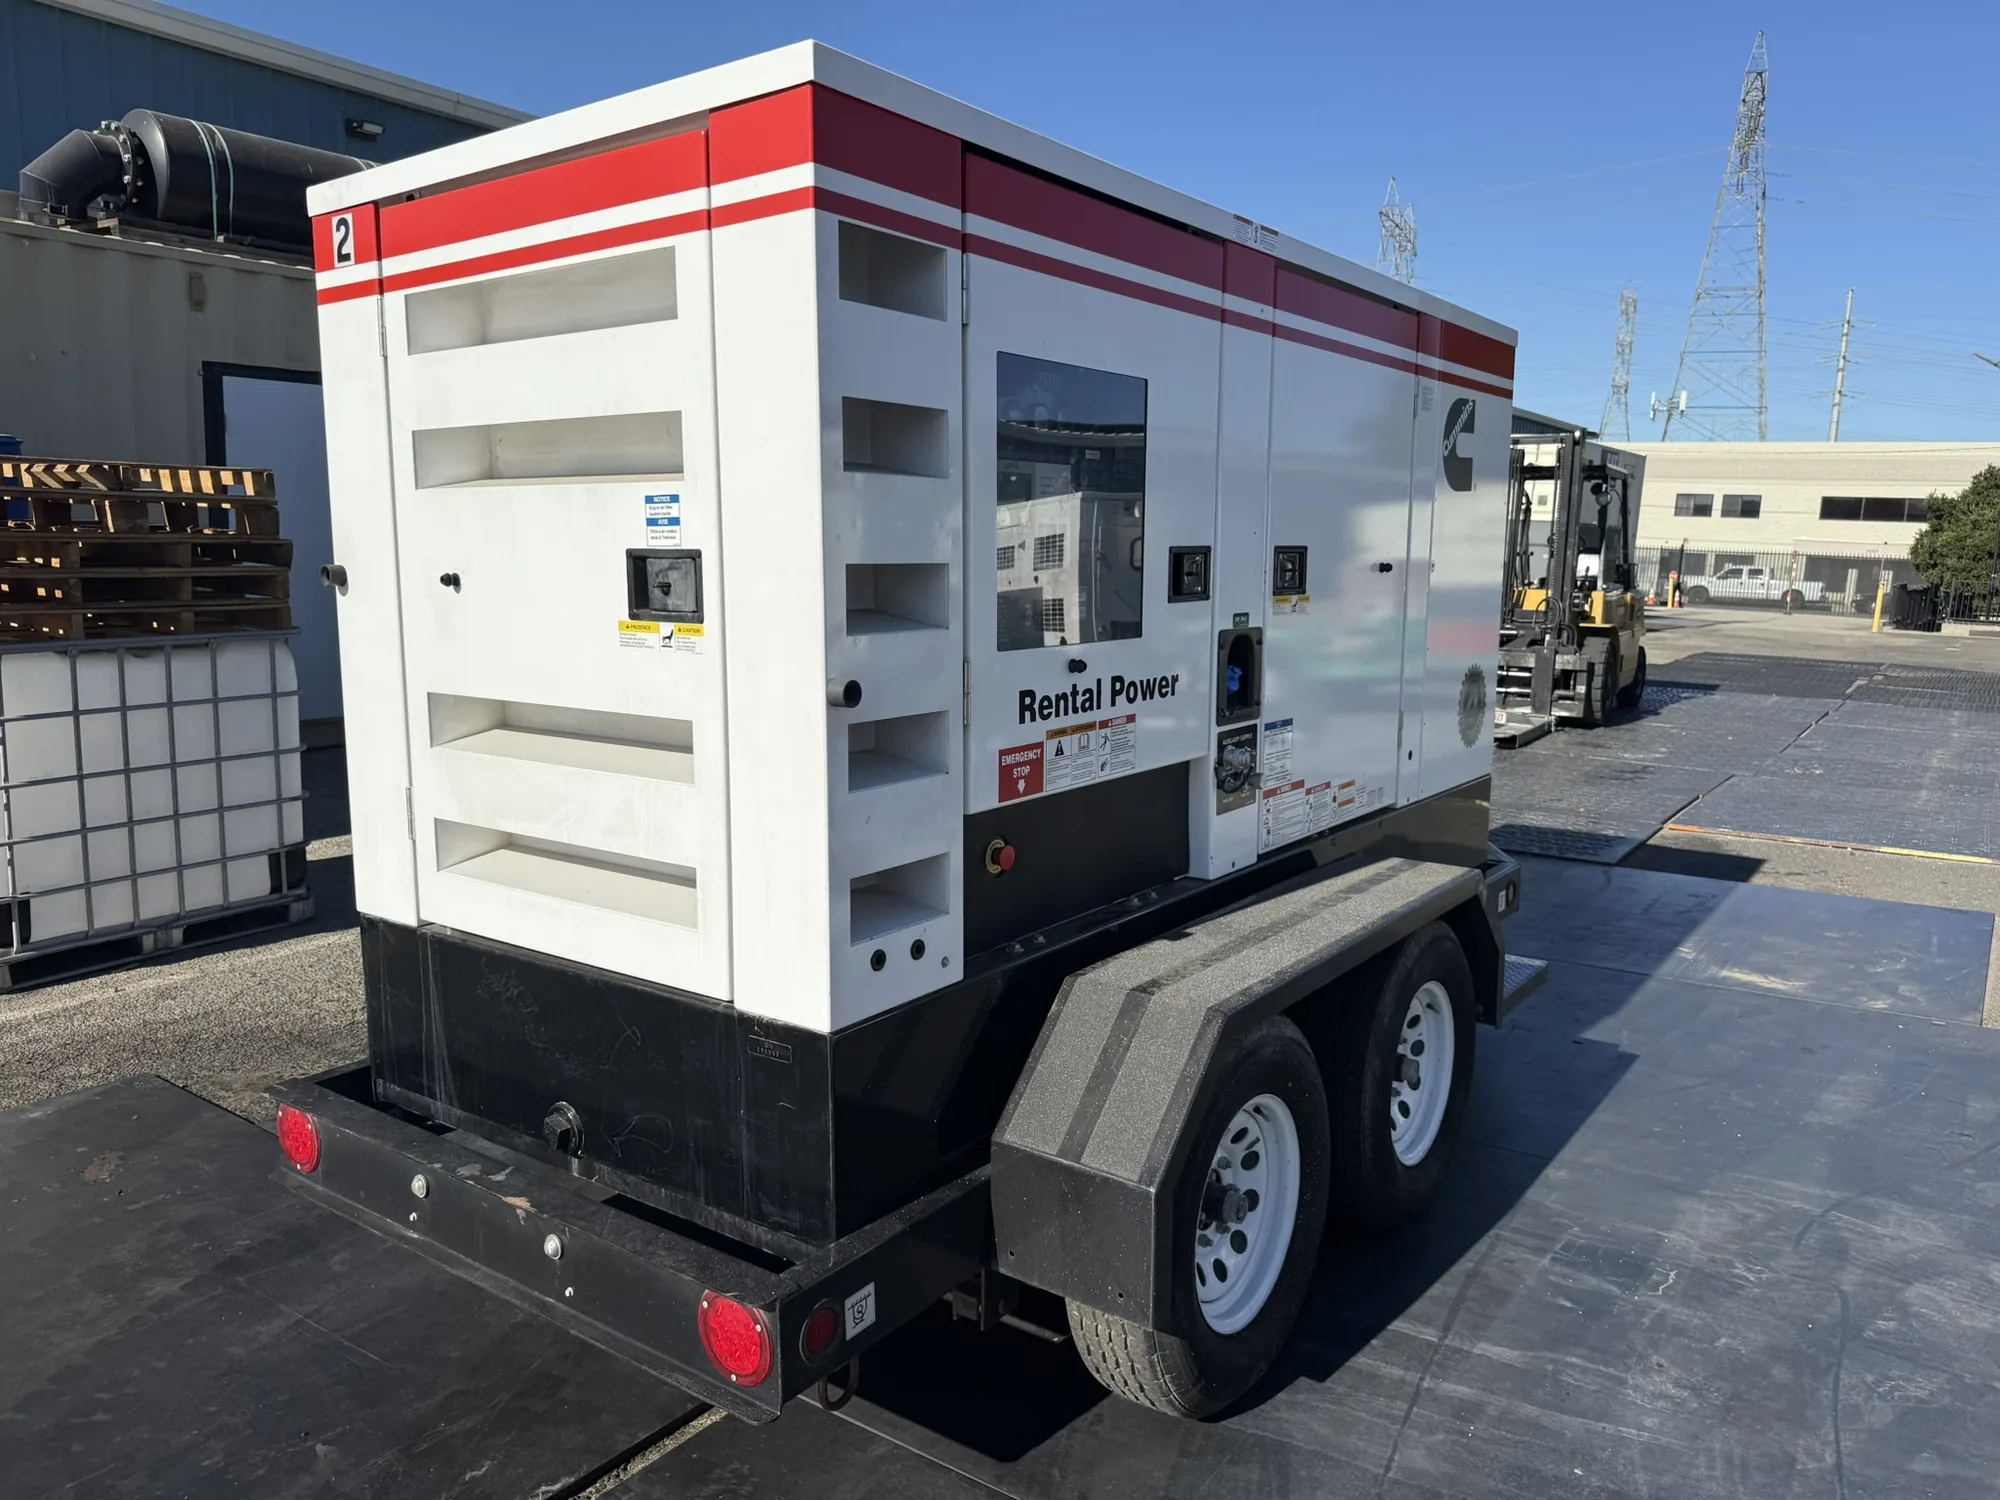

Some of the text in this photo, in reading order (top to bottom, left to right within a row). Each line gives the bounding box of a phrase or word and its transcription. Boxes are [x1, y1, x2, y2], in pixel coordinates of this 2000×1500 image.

[336, 217, 351, 263] 2
[1442, 398, 1474, 457] Cummins
[1019, 673, 1179, 725] Rental Power
[1001, 748, 1042, 766] EMERGENCY
[1013, 765, 1031, 779] STOP
